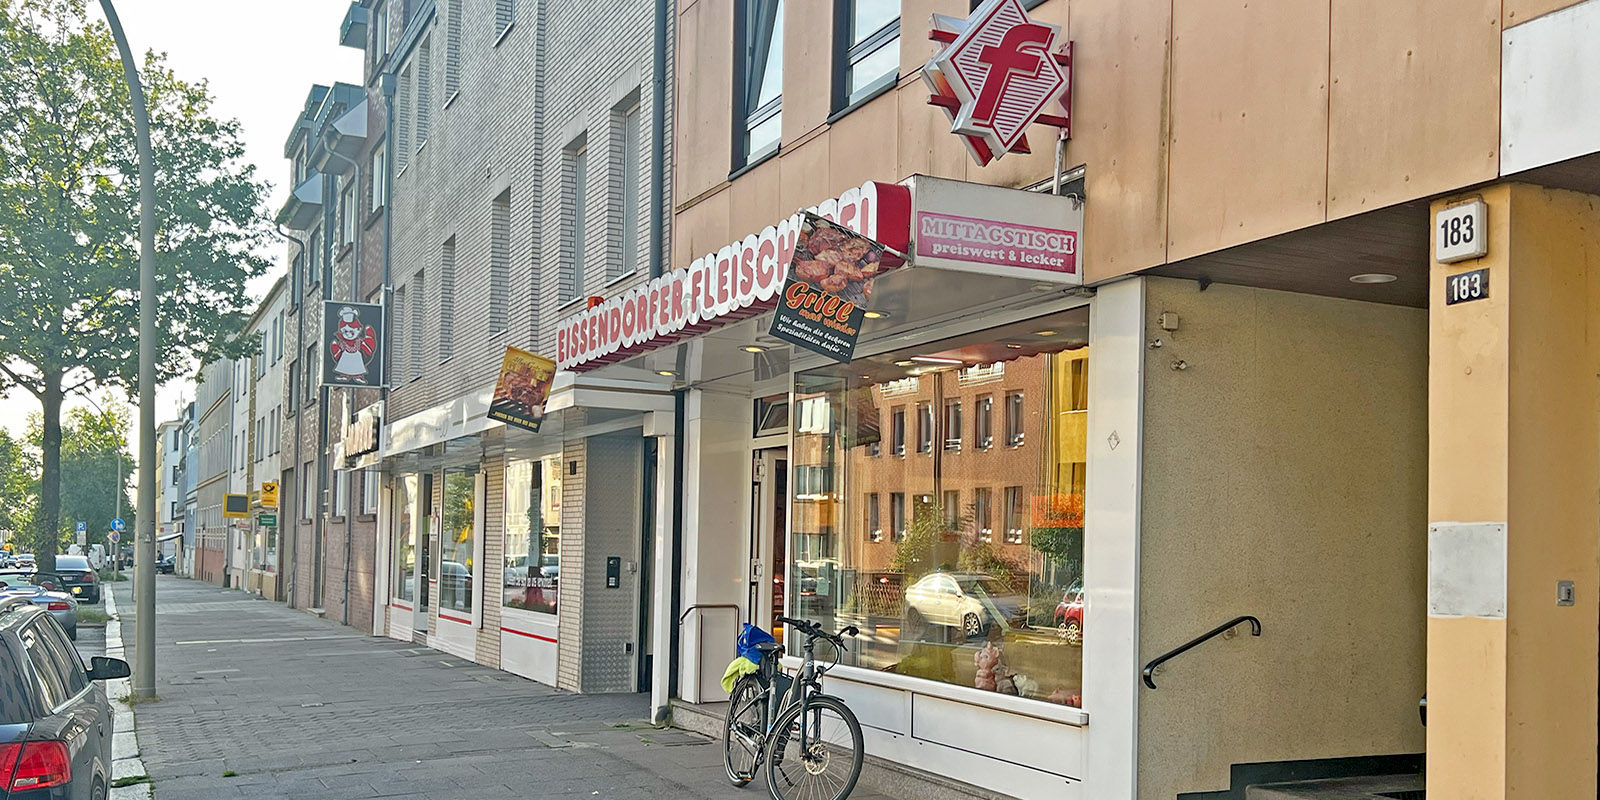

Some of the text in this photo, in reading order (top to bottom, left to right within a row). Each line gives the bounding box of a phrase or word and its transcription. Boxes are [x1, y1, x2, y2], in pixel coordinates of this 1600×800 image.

[923, 217, 1074, 253] MITTAGSTISCH
[1440, 214, 1474, 249] 183
[932, 243, 1065, 267] preiswert & lecker
[557, 197, 870, 364] EISSENDORFER FLEISCHEI
[1451, 273, 1481, 302] 183
[785, 281, 855, 323] Grill
[798, 308, 823, 322] mal
[776, 323, 821, 346] Spezialitäten
[821, 340, 840, 352] dafür
[779, 314, 851, 348] Wir haben die leckeren
